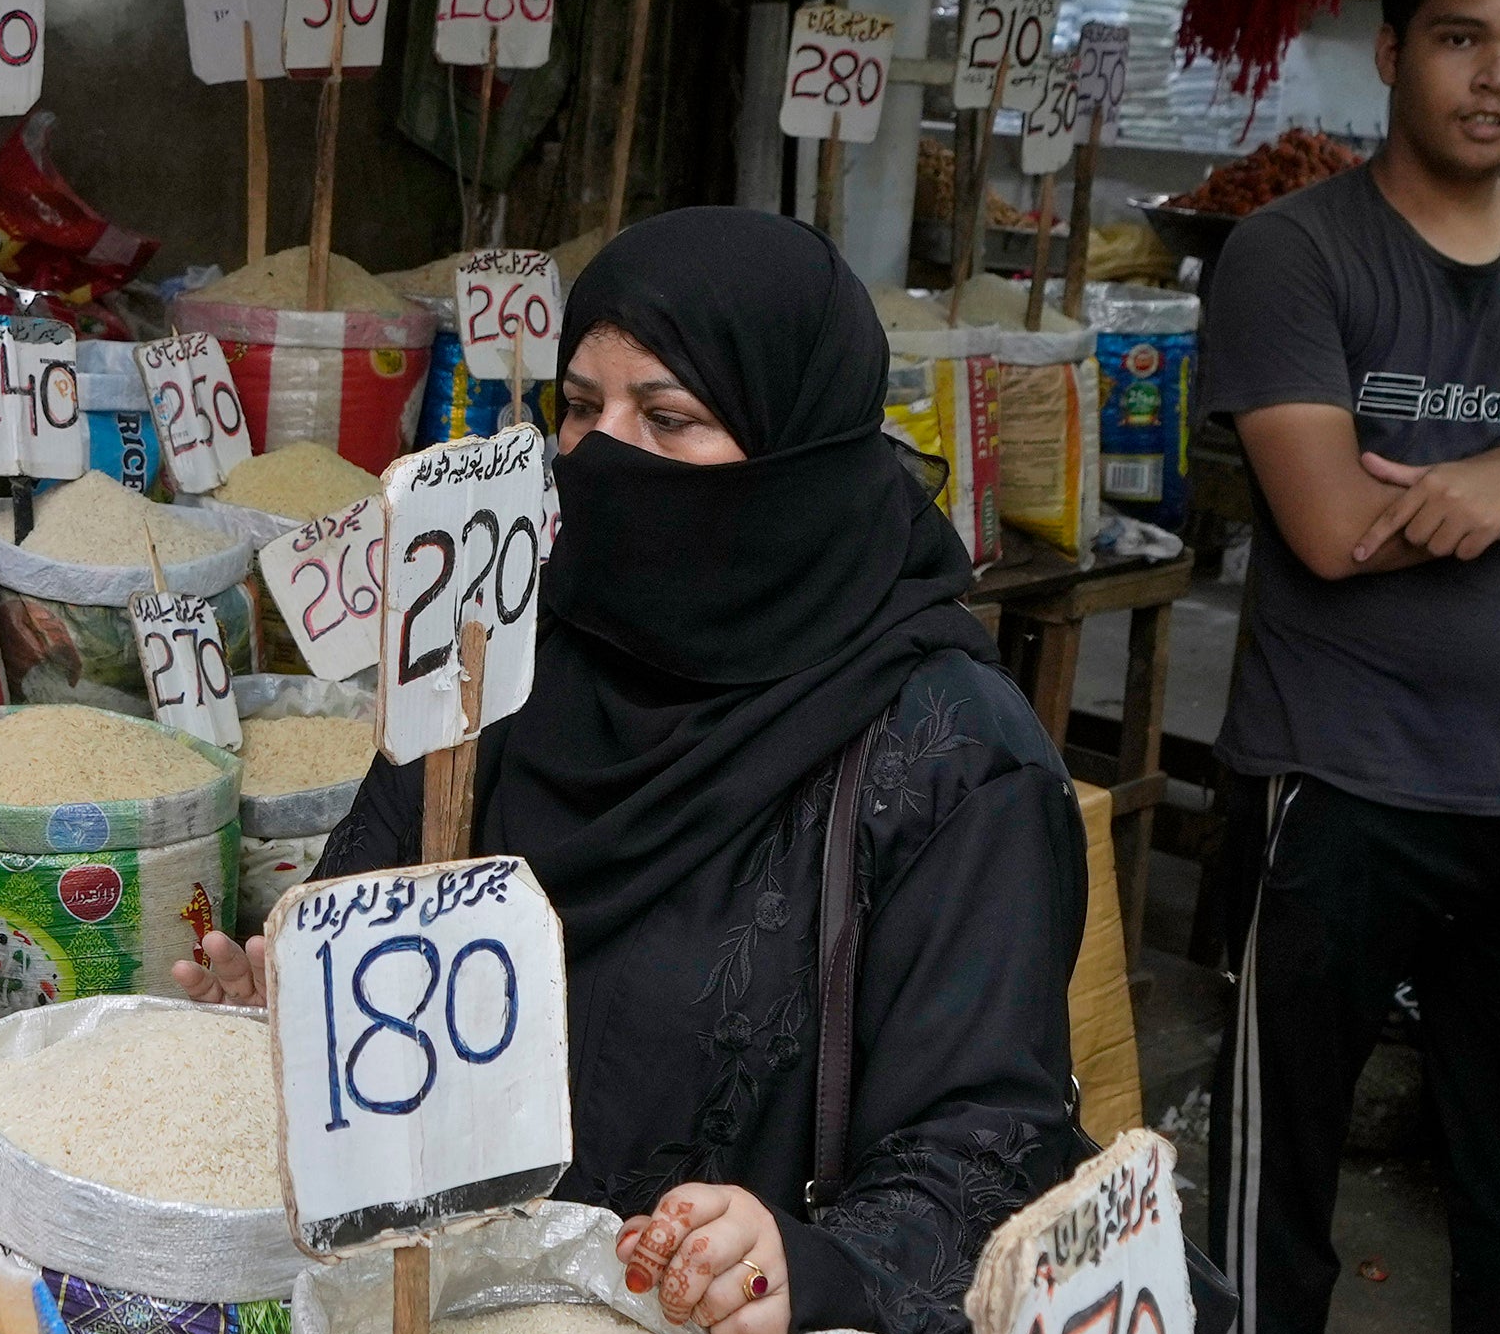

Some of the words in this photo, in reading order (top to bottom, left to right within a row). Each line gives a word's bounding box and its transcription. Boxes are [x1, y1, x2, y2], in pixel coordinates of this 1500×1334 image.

[969, 8, 1042, 68] 210
[791, 44, 883, 106] 280
[1080, 47, 1126, 106] 250
[466, 283, 551, 345] 260
[159, 374, 242, 457] 250
[975, 416, 989, 460] RICE
[117, 412, 146, 493] RICE
[398, 508, 540, 687] 220
[144, 627, 231, 709] 270
[315, 934, 519, 1132] 180
